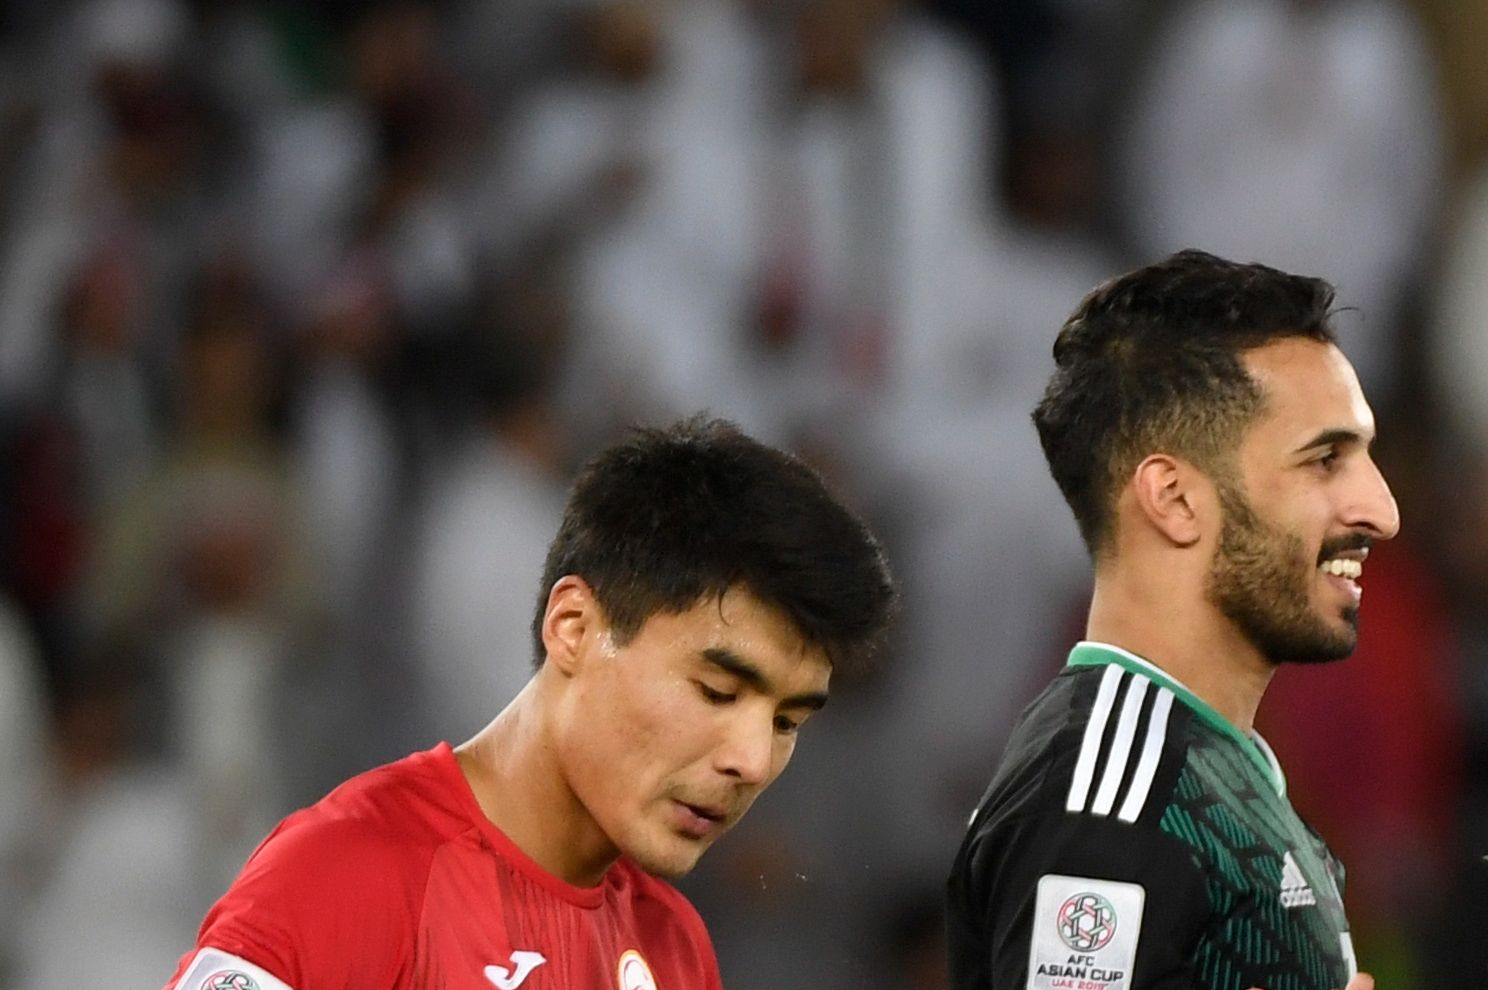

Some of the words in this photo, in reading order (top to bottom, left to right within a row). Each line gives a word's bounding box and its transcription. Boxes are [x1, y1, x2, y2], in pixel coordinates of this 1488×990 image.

[1067, 954, 1095, 967] AFC
[1036, 963, 1087, 980] ASIAN
[1090, 969, 1124, 982] CUP
[1051, 979, 1073, 989] UAE
